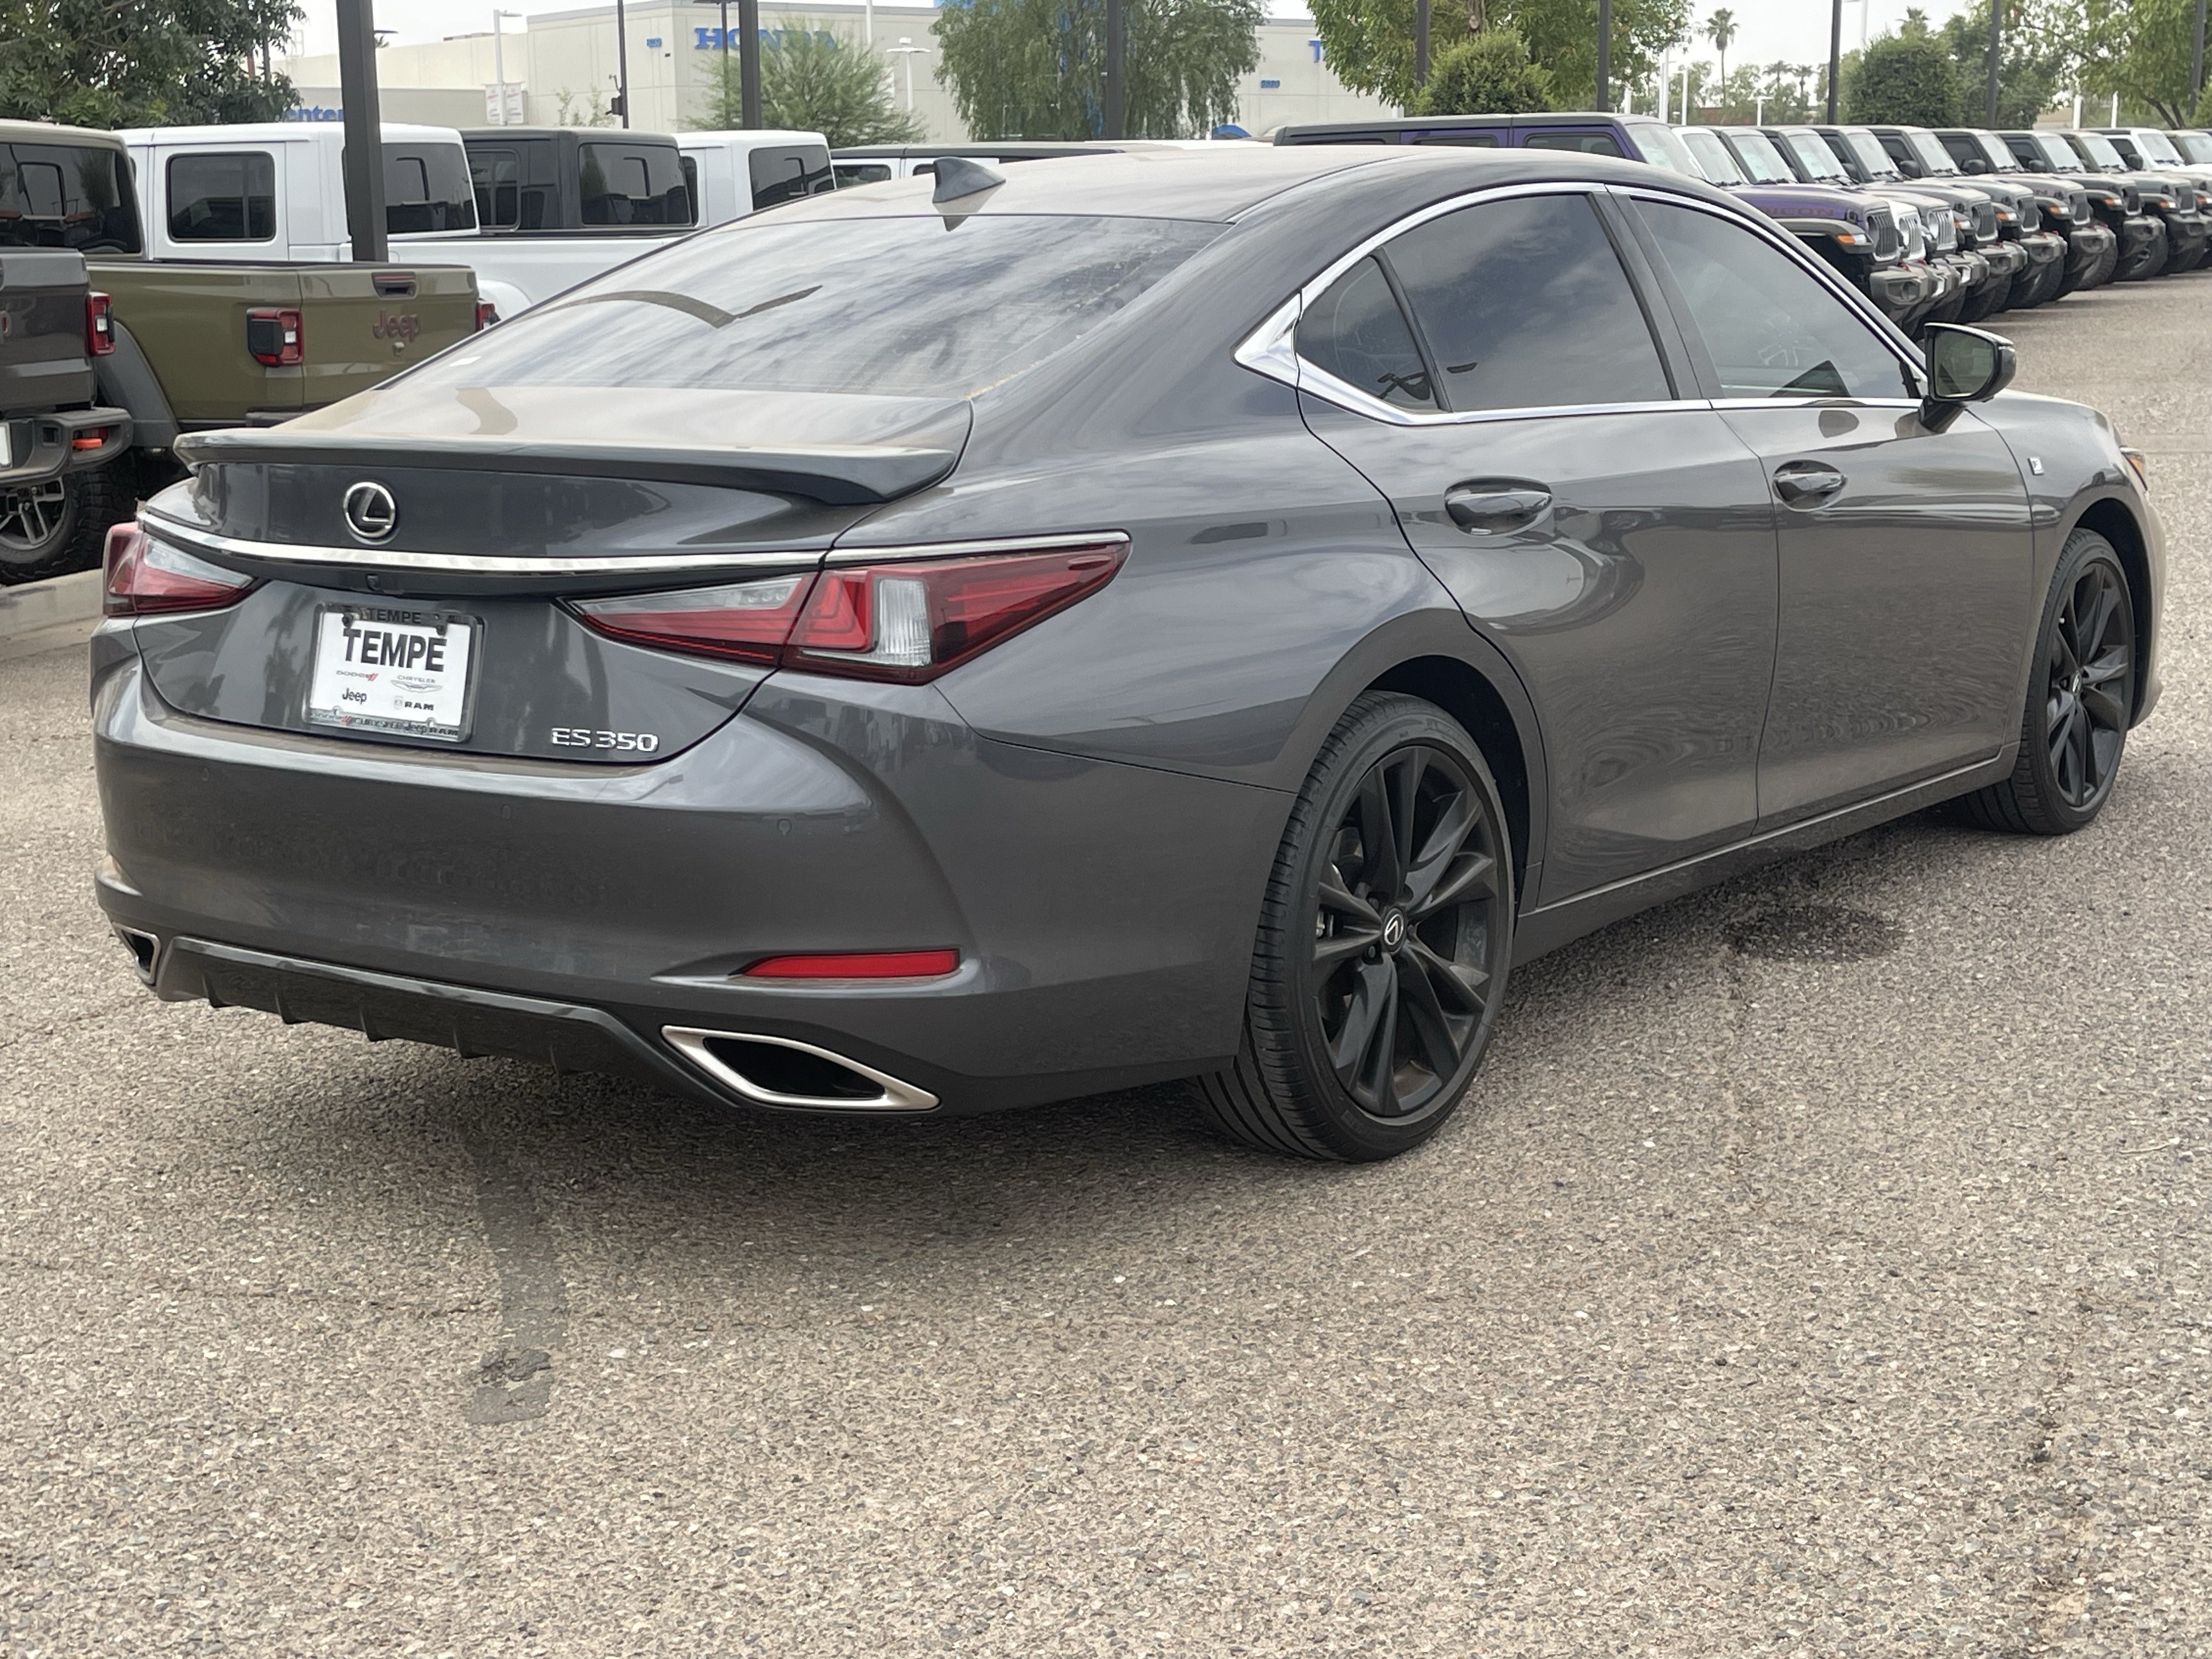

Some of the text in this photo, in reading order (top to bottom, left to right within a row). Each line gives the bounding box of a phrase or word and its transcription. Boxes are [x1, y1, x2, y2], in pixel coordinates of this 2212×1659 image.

[371, 309, 420, 343] Jeep
[367, 608, 422, 624] TEMPE
[343, 628, 447, 672] TEMPE
[397, 675, 436, 684] CHRYSLER
[342, 687, 367, 705] Jeep
[404, 701, 435, 711] RAM
[404, 721, 427, 736] Jeep
[428, 726, 459, 736] RAM
[552, 727, 659, 752] ES 350
